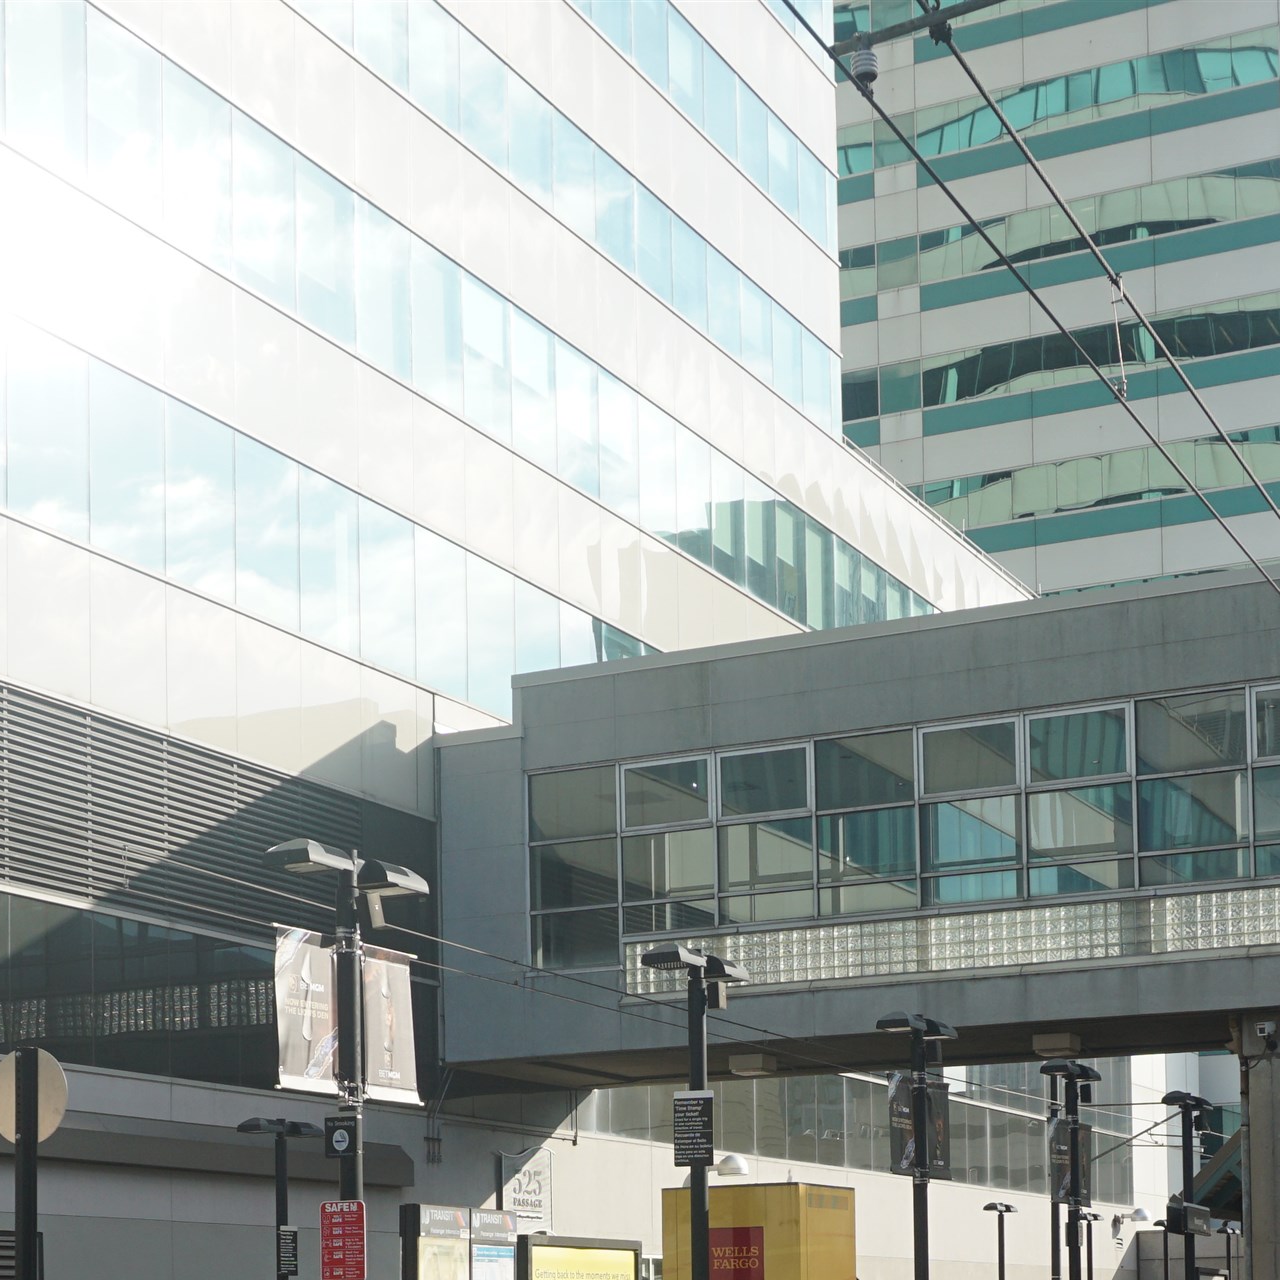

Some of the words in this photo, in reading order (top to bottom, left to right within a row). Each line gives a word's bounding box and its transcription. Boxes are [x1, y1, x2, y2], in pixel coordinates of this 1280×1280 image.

[513, 1169, 543, 1196] 525
[325, 1203, 350, 1212] SAFE
[513, 1197, 543, 1208] PASSAGE
[430, 1209, 455, 1221] TRANSIT
[480, 1213, 503, 1225] TRANSIT
[711, 1246, 759, 1258] WELLS
[713, 1258, 759, 1270] FARGO
[535, 1269, 556, 1280] Getting
[557, 1269, 569, 1279] back
[570, 1271, 575, 1279] to
[576, 1270, 585, 1280] the
[585, 1272, 610, 1280] moments
[611, 1273, 619, 1280] we
